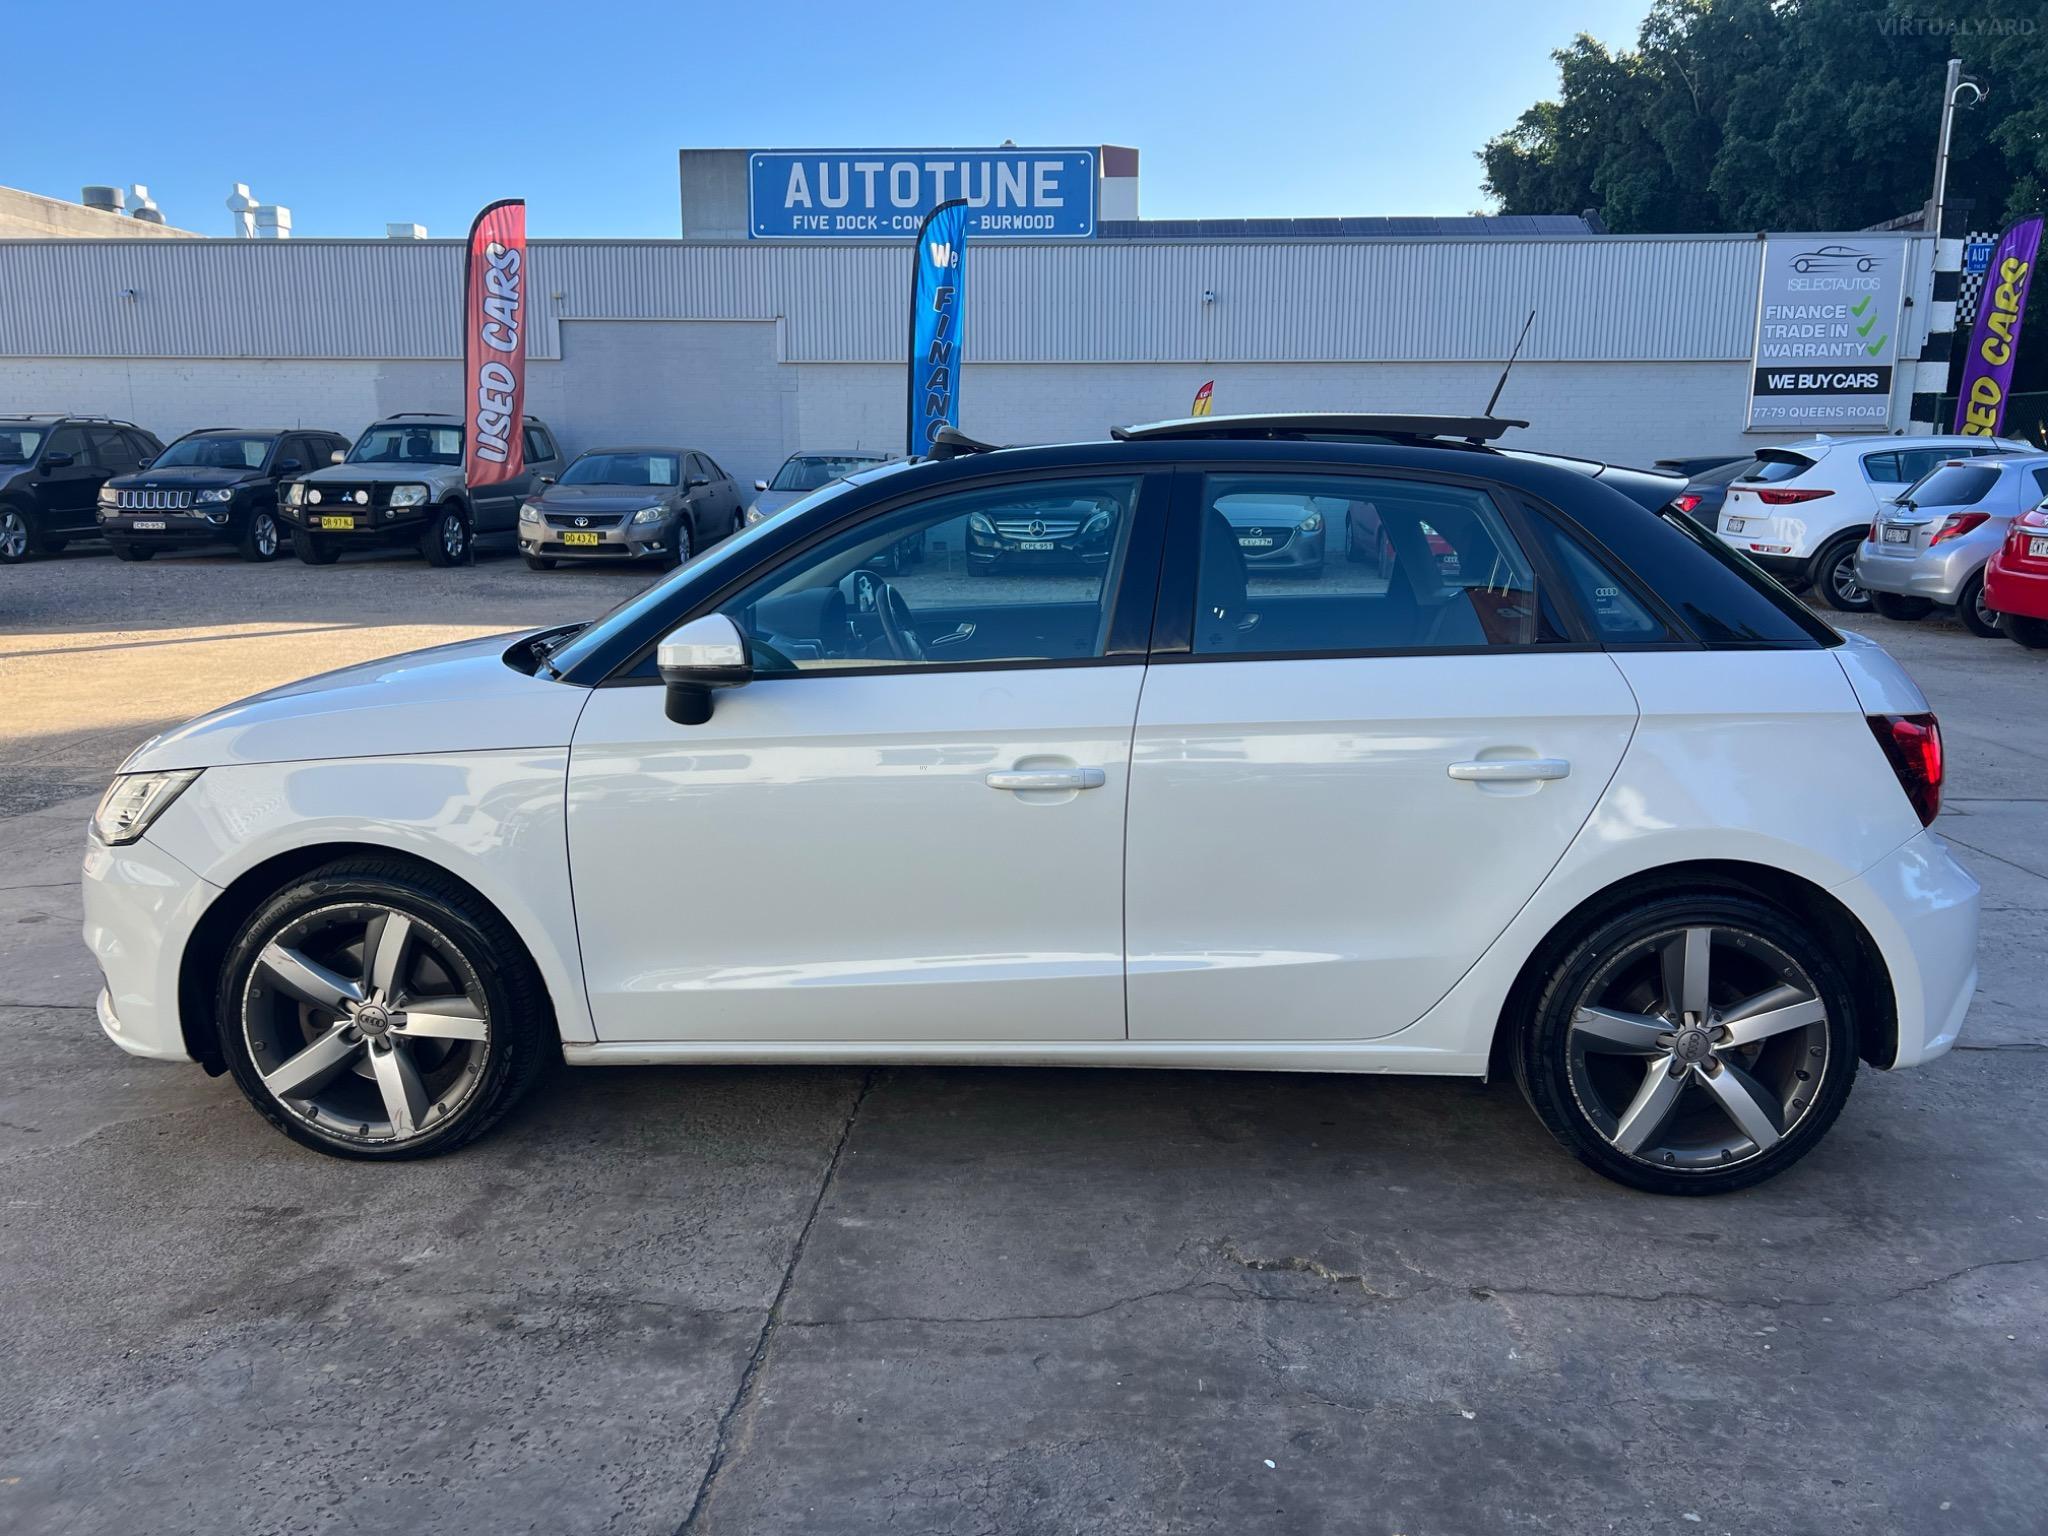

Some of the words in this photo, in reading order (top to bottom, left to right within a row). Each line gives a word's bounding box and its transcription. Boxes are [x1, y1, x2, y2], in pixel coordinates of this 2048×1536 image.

[784, 161, 1064, 208] AUTOTUNE
[793, 215, 829, 230] FIVE
[836, 215, 878, 230] DOCK
[981, 215, 1055, 230] BURWOOD
[931, 243, 958, 268] We
[1788, 278, 1880, 291] ISELECTAUTOS
[481, 242, 521, 353] CARS
[1765, 304, 1846, 320] FINANCE
[1981, 257, 2029, 366] CARS
[1764, 323, 1826, 338] TRADE
[1830, 323, 1848, 337] IN
[1762, 342, 1867, 358] WARRANTY
[925, 286, 955, 446] FINANC
[1768, 374, 1795, 389] WE
[1798, 374, 1834, 389] BUY
[1833, 373, 1879, 388] CARS
[476, 361, 516, 463] USED
[1753, 407, 1786, 418] 77-79
[1789, 407, 1844, 418] QUEENS
[1847, 406, 1886, 417] ROAD
